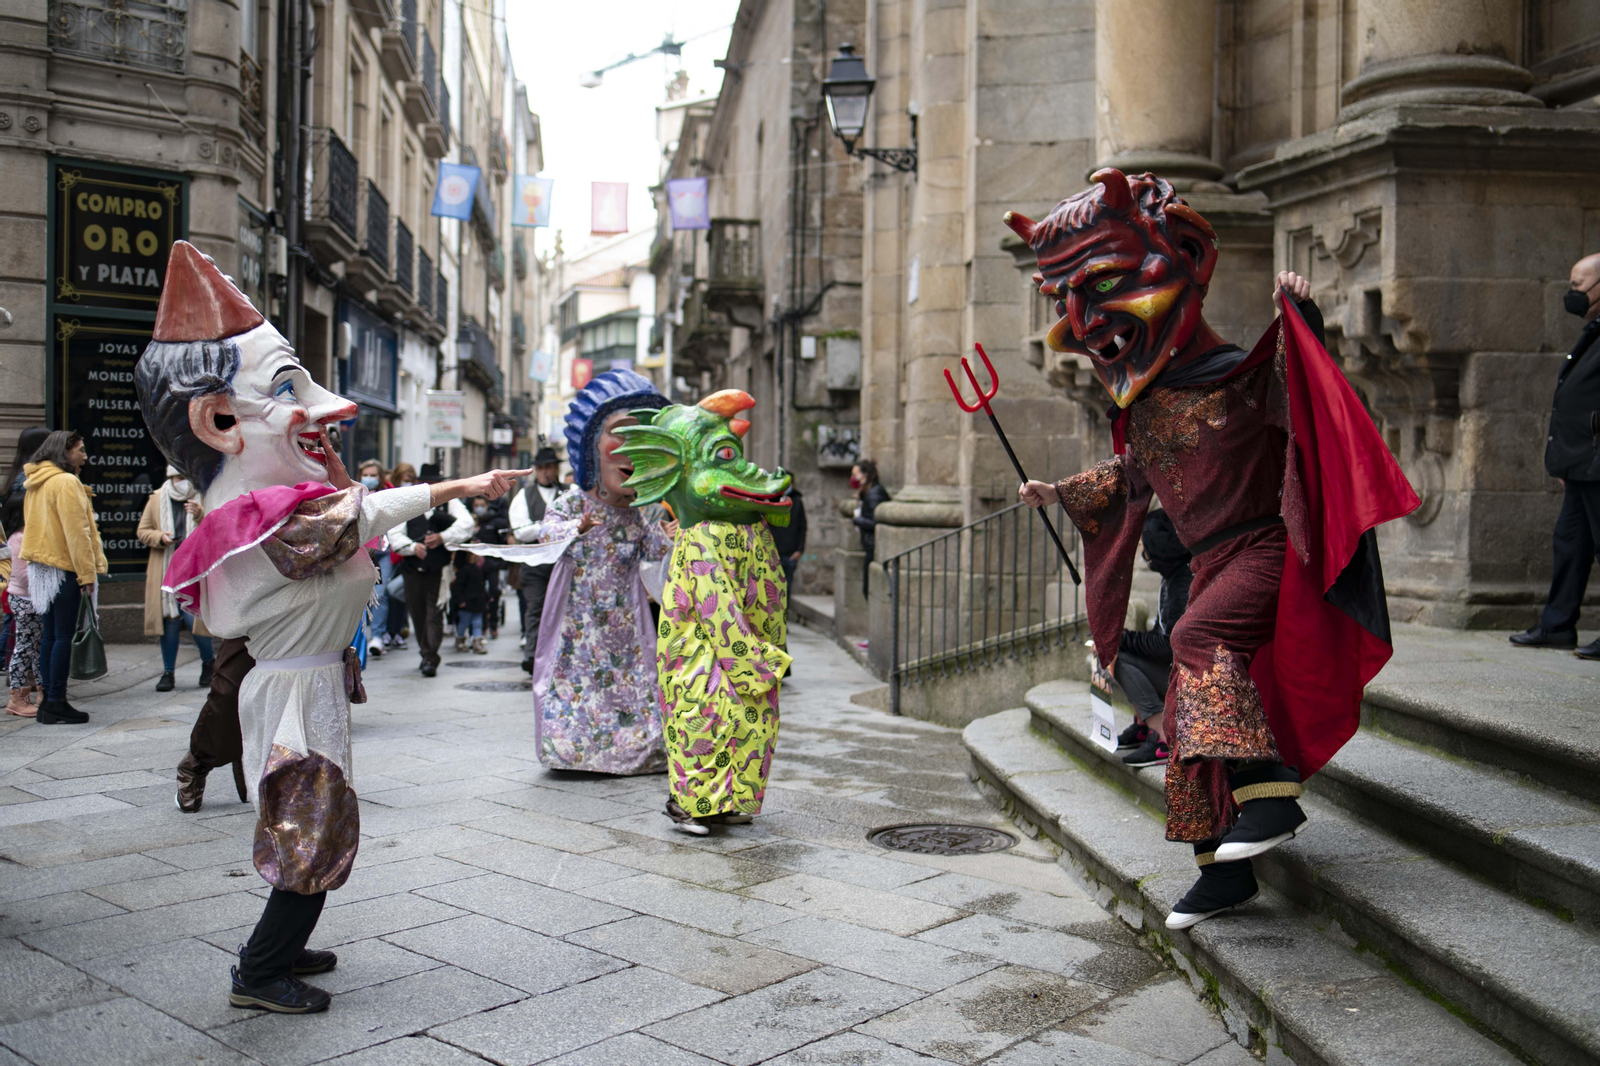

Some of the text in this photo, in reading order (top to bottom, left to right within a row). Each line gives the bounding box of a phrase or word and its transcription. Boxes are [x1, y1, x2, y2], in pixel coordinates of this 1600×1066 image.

[76, 192, 162, 220] COMPRO
[83, 224, 158, 256] ORO
[79, 263, 160, 288] Y PLATA
[98, 343, 138, 354] JOYAS
[88, 371, 134, 382] MONED
[88, 399, 141, 410] PULSERA
[92, 427, 144, 438] ANILLOS
[89, 455, 147, 466] CADENAS
[84, 483, 153, 494] ENDIENTES
[98, 511, 143, 522] ELOJES
[102, 539, 147, 549] NGOTE
